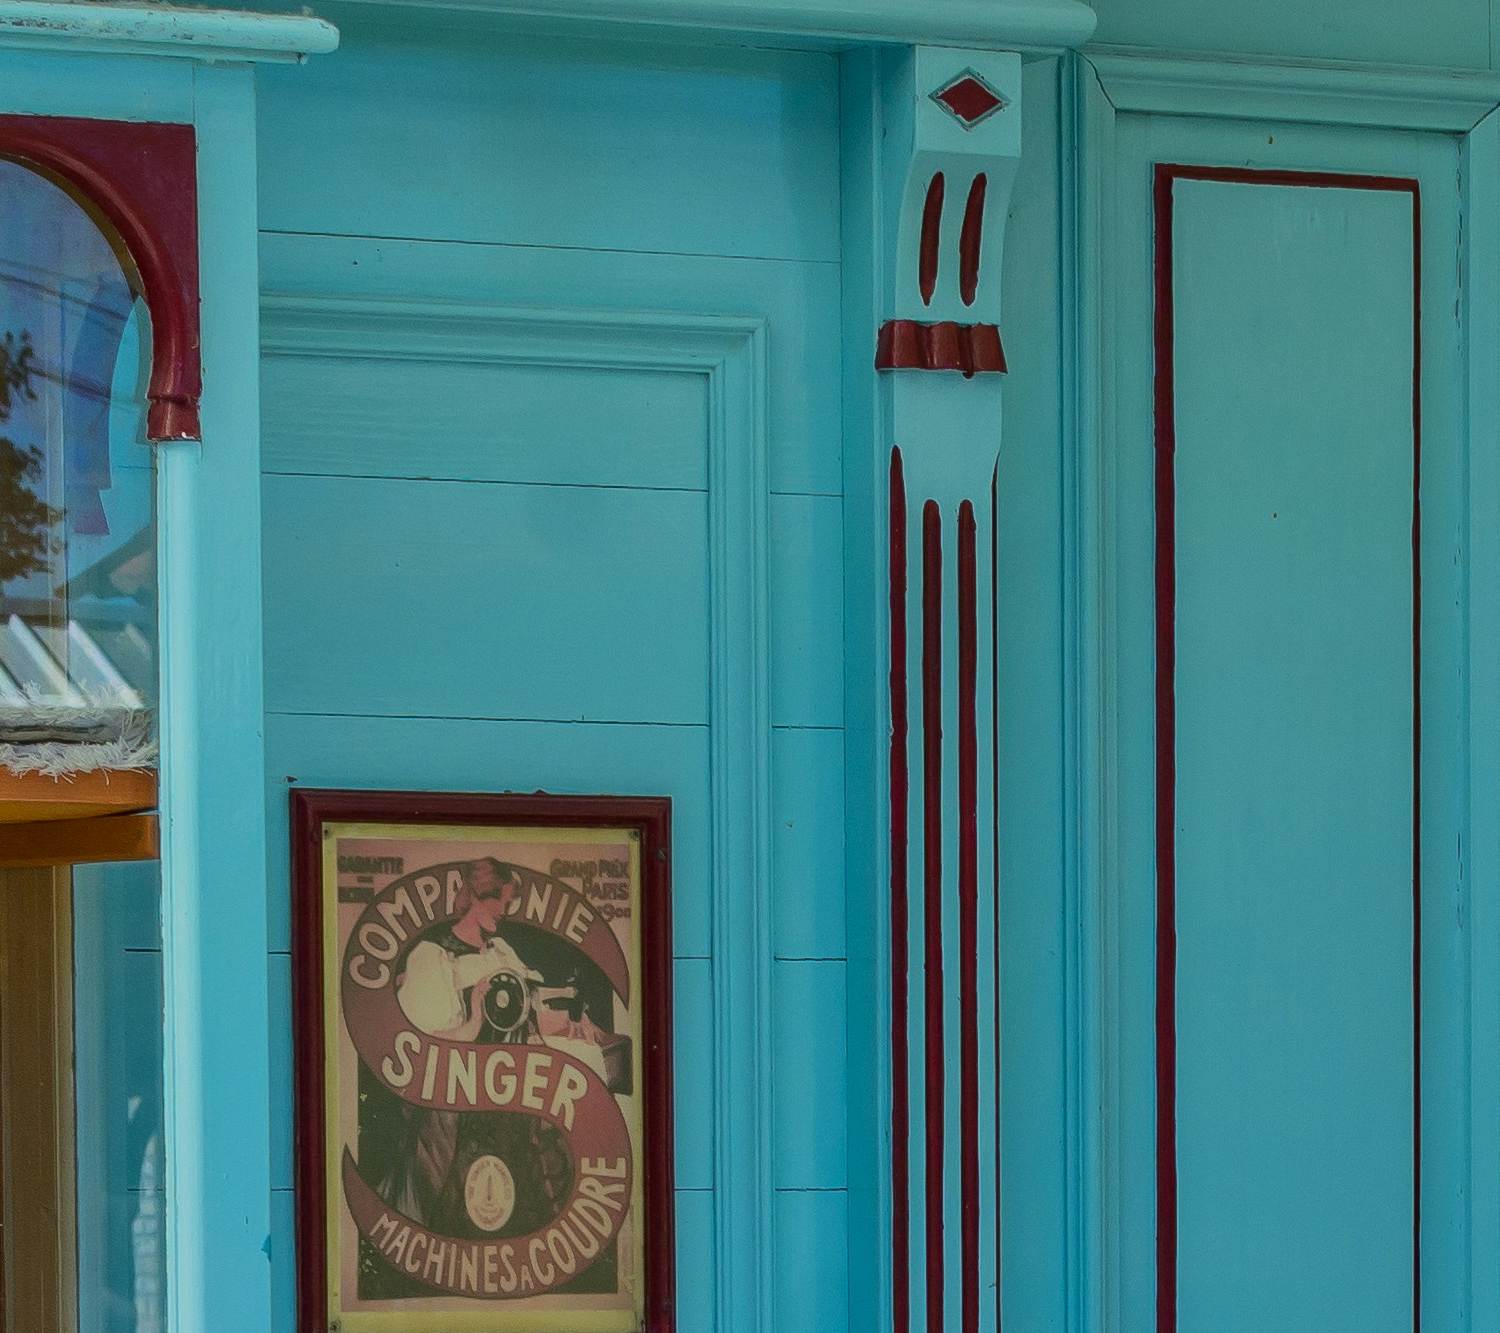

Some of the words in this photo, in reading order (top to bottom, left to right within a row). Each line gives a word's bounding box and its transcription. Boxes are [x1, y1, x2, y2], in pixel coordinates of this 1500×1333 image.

[381, 1029, 588, 1132] SINGER
[369, 1212, 518, 1294] MACHINES
[528, 1156, 627, 1286] COUDRE
